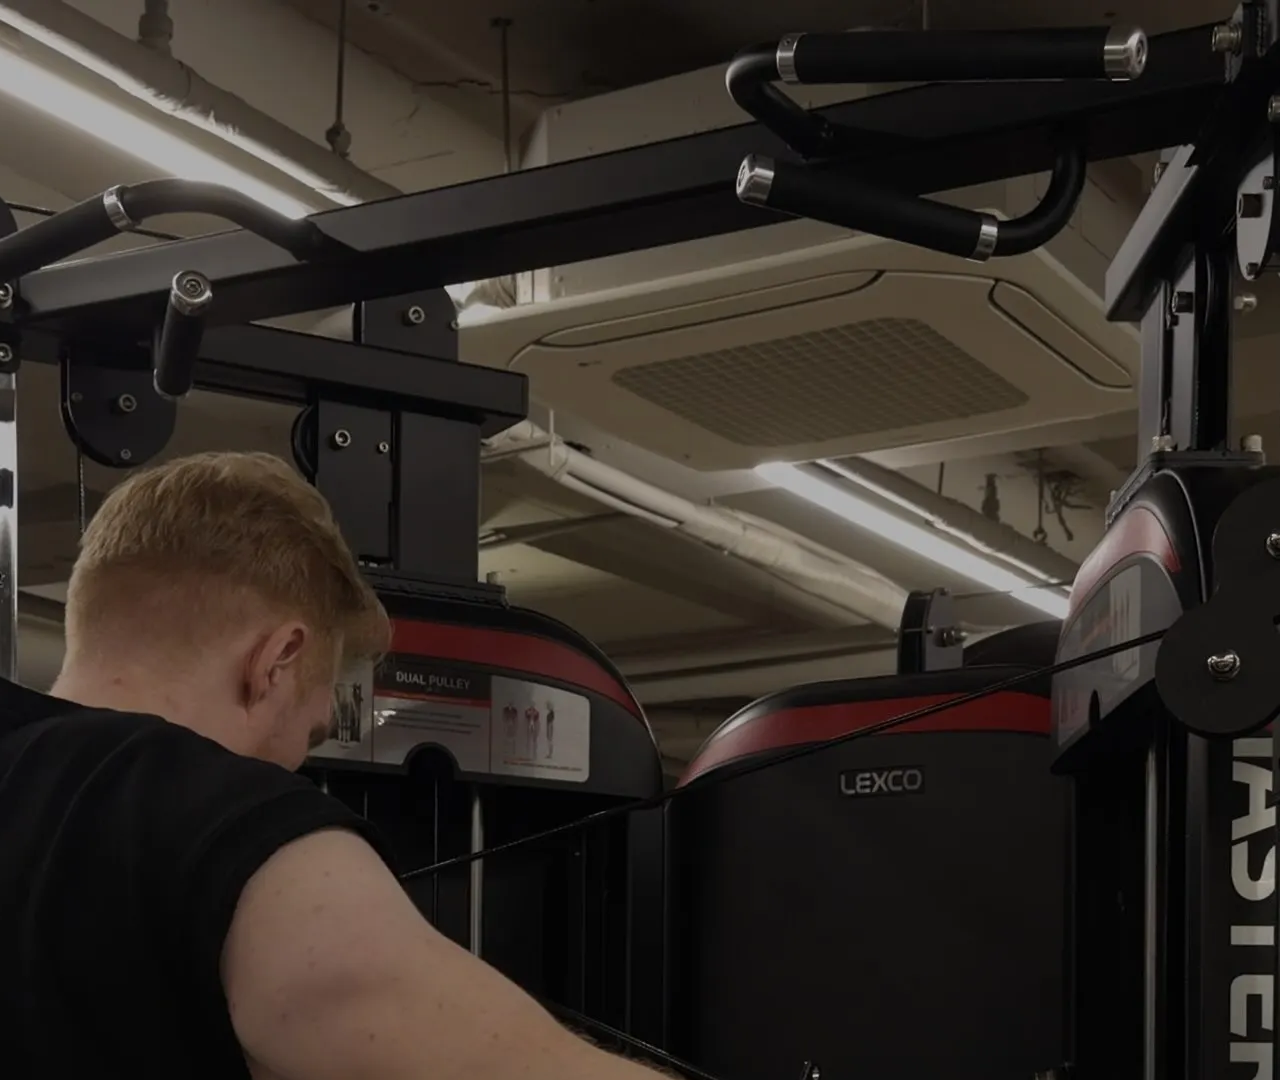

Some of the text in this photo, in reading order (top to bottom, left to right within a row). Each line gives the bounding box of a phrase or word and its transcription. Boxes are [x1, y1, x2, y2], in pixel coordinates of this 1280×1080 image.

[395, 670, 427, 686] DUAL
[428, 674, 471, 690] PULLEY
[840, 768, 923, 795] LEXCO
